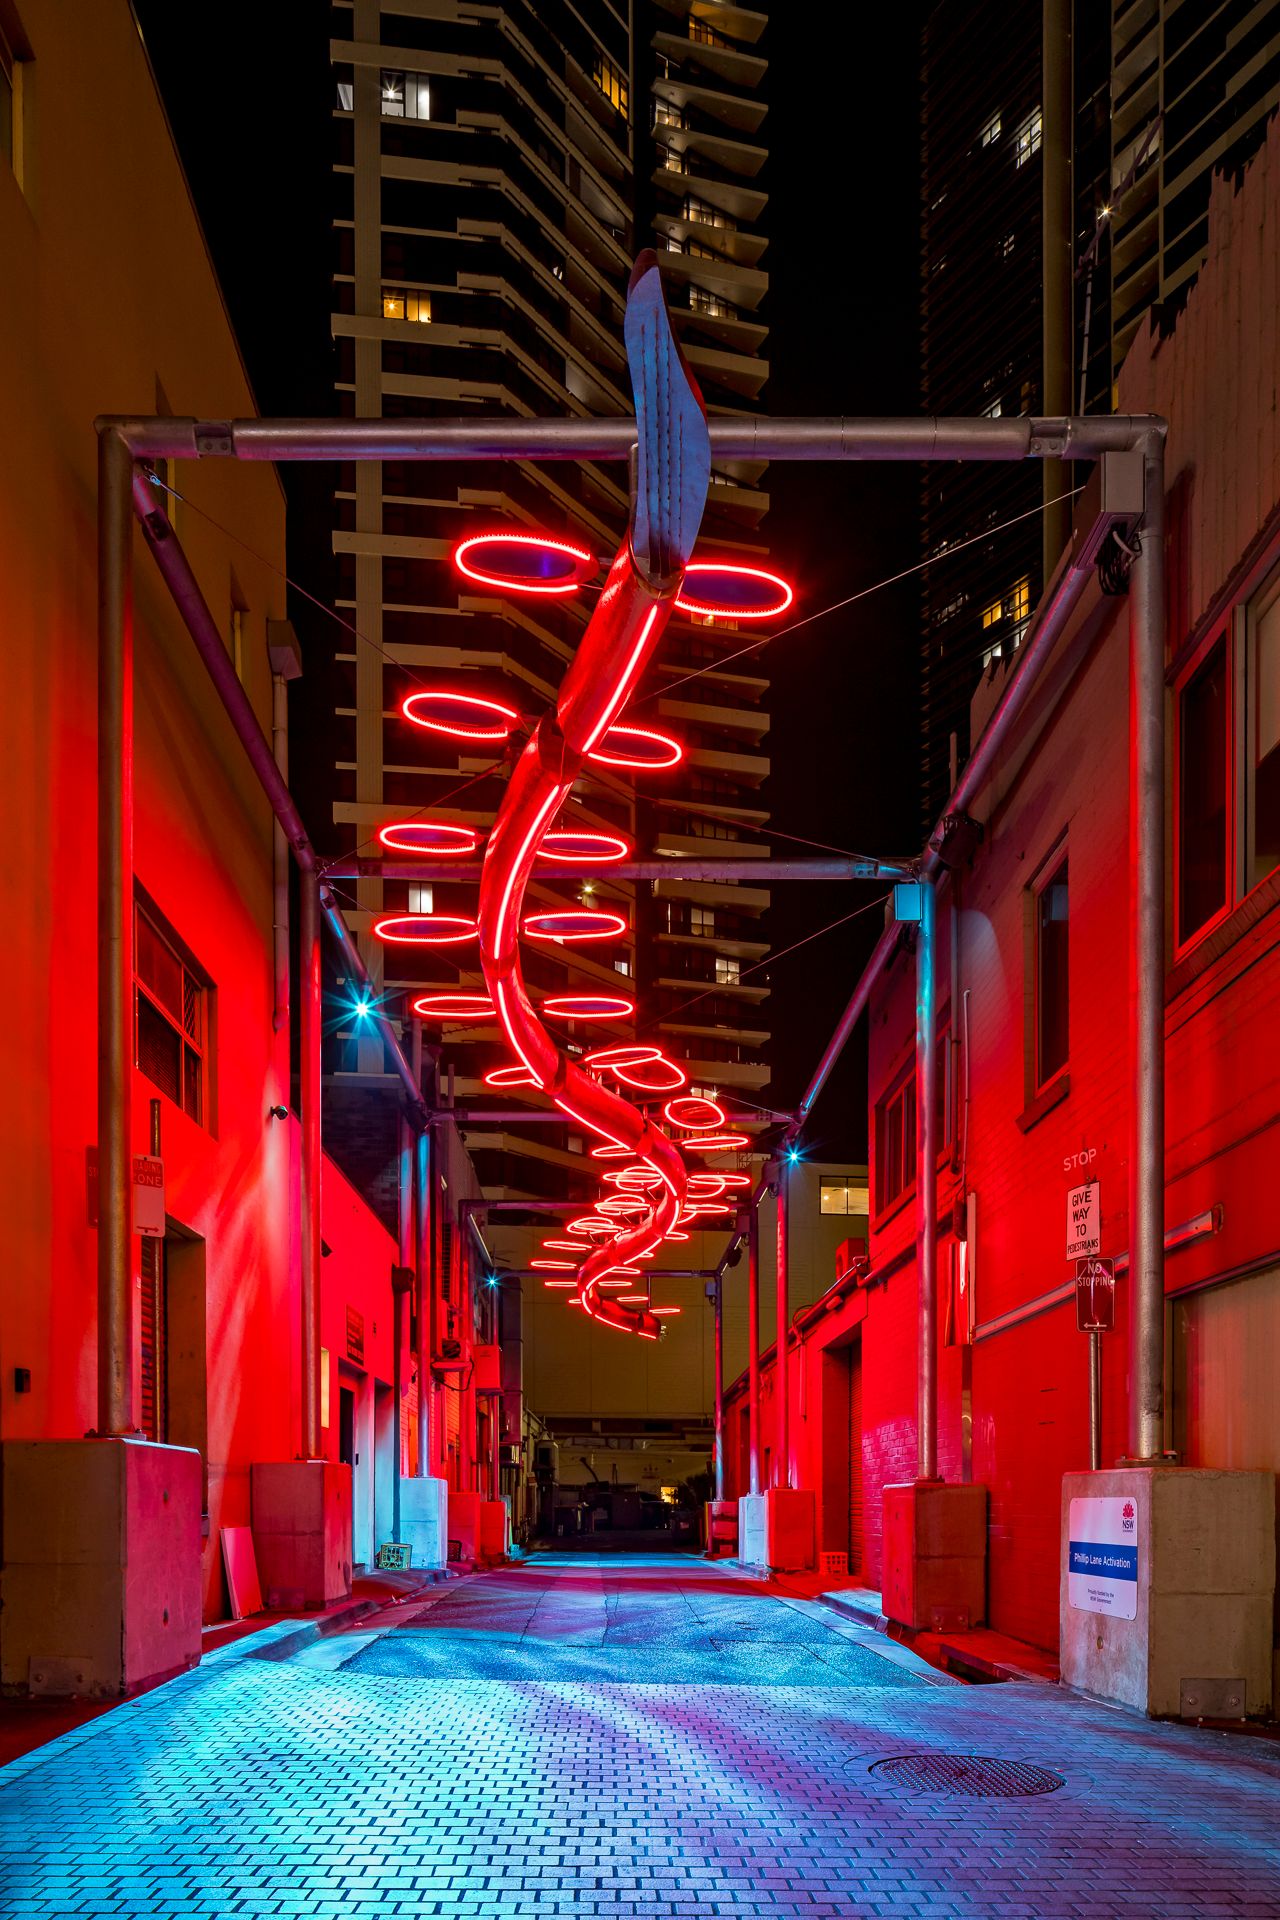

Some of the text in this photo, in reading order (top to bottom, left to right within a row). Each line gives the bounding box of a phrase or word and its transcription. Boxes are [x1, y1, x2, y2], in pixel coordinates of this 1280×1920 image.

[1063, 1148, 1097, 1172] STOP
[134, 1161, 160, 1174] OADING
[1072, 1190, 1092, 1206] GIVE
[1072, 1206, 1090, 1222] WAY
[1076, 1223, 1086, 1237] TO
[1068, 1238, 1098, 1254] PEDESTRIANS
[1087, 1262, 1102, 1274] NO
[1122, 1520, 1134, 1529] NSW
[1089, 1554, 1102, 1565] Lane
[1103, 1556, 1131, 1568] Activation
